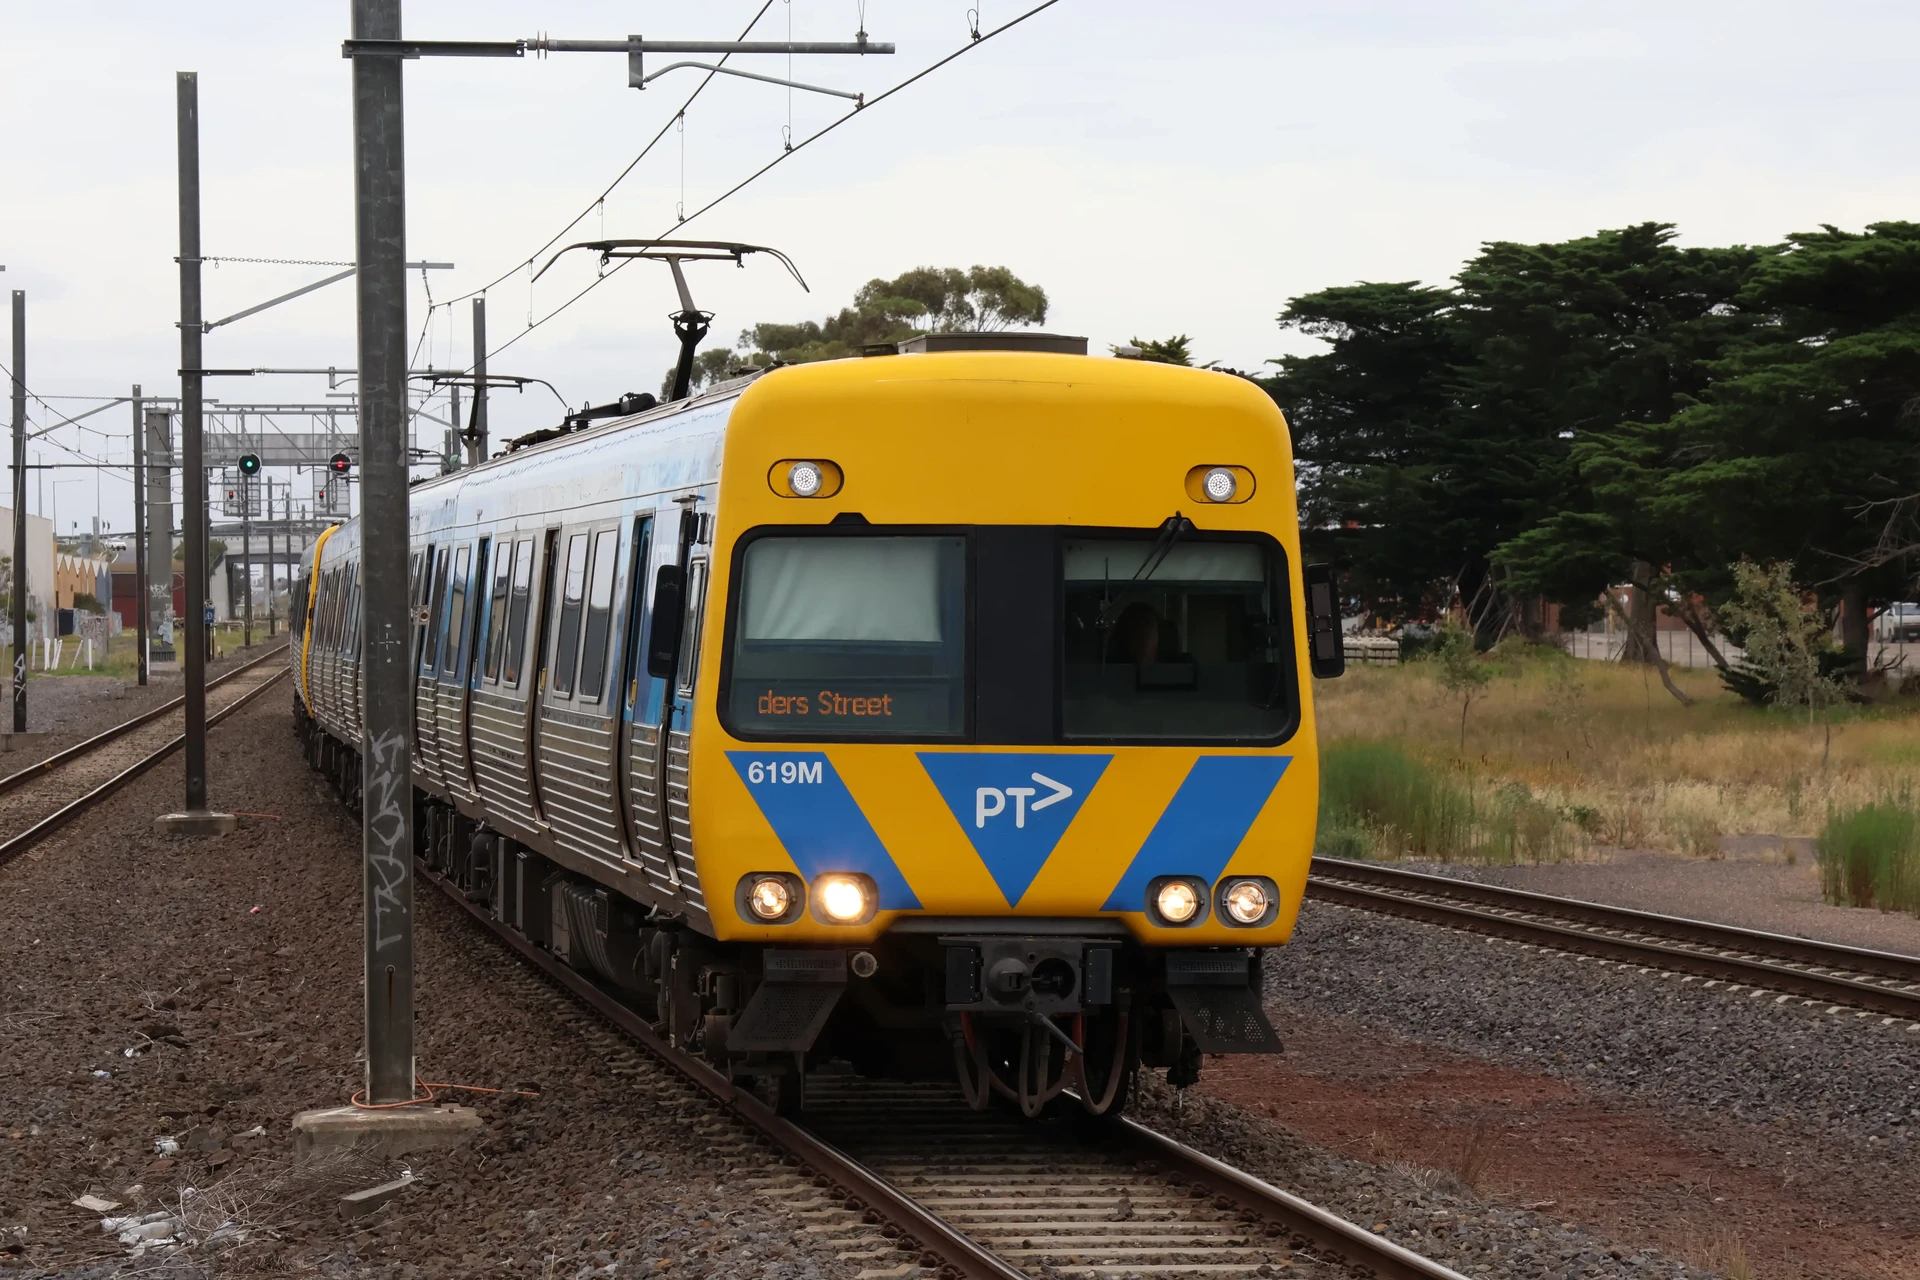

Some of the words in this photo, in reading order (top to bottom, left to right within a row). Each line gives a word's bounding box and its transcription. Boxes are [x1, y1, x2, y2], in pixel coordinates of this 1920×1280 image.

[758, 690, 809, 715] ders
[818, 691, 893, 716] Street
[748, 761, 822, 784] 619M
